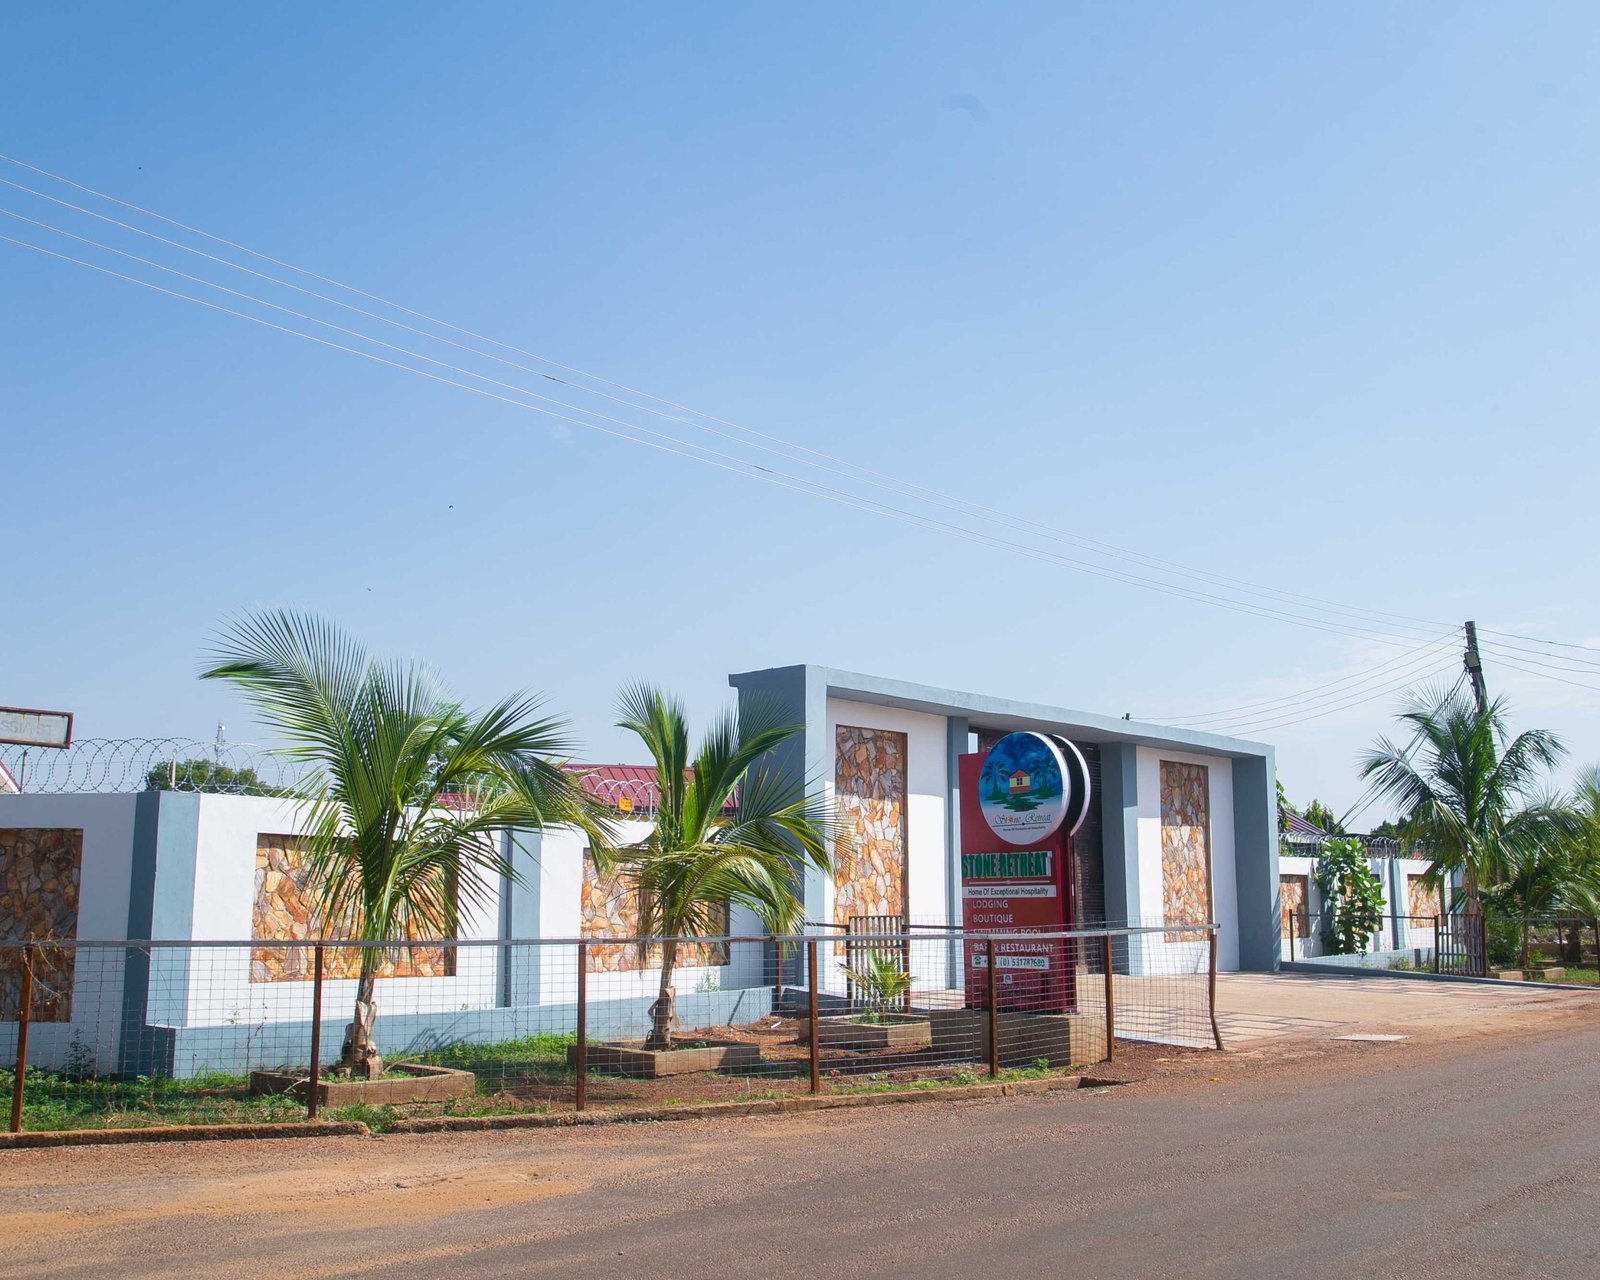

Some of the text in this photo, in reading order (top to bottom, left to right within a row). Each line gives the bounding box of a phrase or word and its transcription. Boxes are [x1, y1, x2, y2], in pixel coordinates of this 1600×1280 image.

[961, 852, 1048, 877] STONE RETREAT
[991, 888, 1020, 897] Exceptional
[1021, 887, 1048, 897] Hospitality
[972, 900, 1008, 908] LODGING
[973, 914, 1013, 923] BOUTIQUE
[1001, 943, 1053, 952] RESTAURANT
